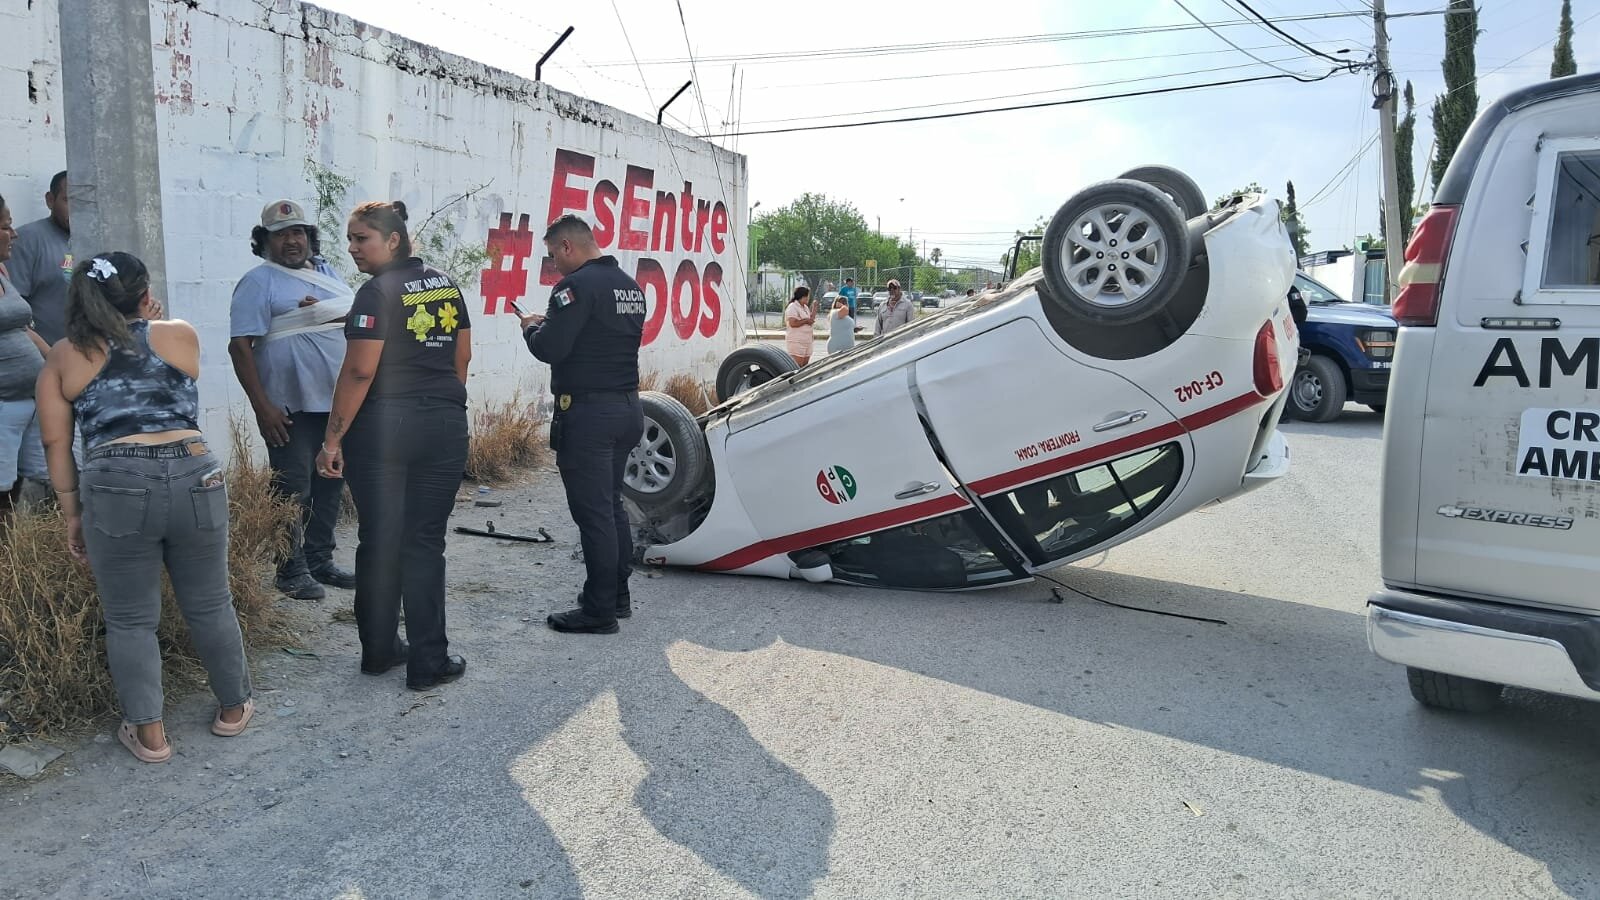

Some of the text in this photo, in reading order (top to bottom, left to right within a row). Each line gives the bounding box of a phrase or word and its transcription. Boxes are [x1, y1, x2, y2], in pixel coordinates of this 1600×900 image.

[404, 276, 451, 293] CRUZ AMBAR
[616, 302, 646, 314] MUNICIPAL
[1174, 370, 1224, 403] CF-042
[1462, 507, 1574, 530] EXPRESS
